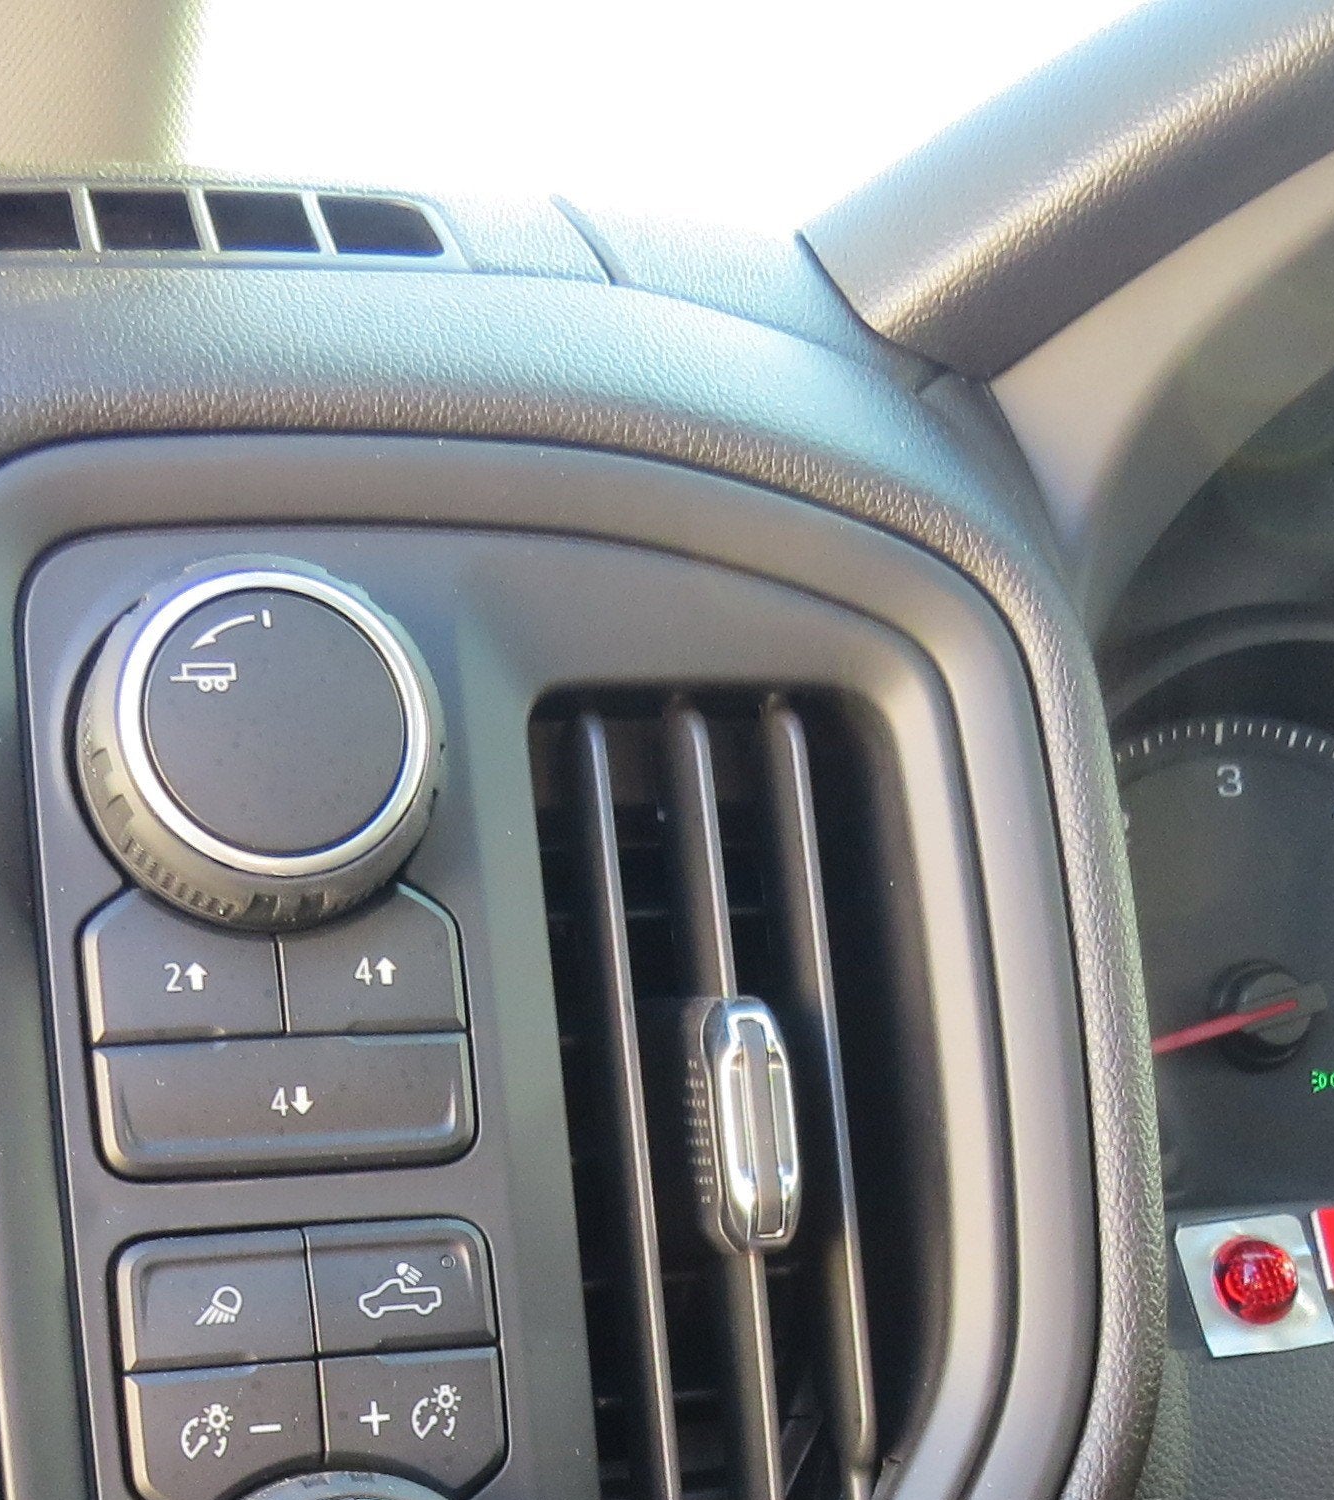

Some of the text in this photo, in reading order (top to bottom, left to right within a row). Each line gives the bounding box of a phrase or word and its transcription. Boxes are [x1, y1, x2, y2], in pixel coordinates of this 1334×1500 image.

[1216, 764, 1243, 797] 3
[164, 962, 183, 992] 2
[354, 957, 373, 985] 4
[271, 1087, 289, 1116] 4
